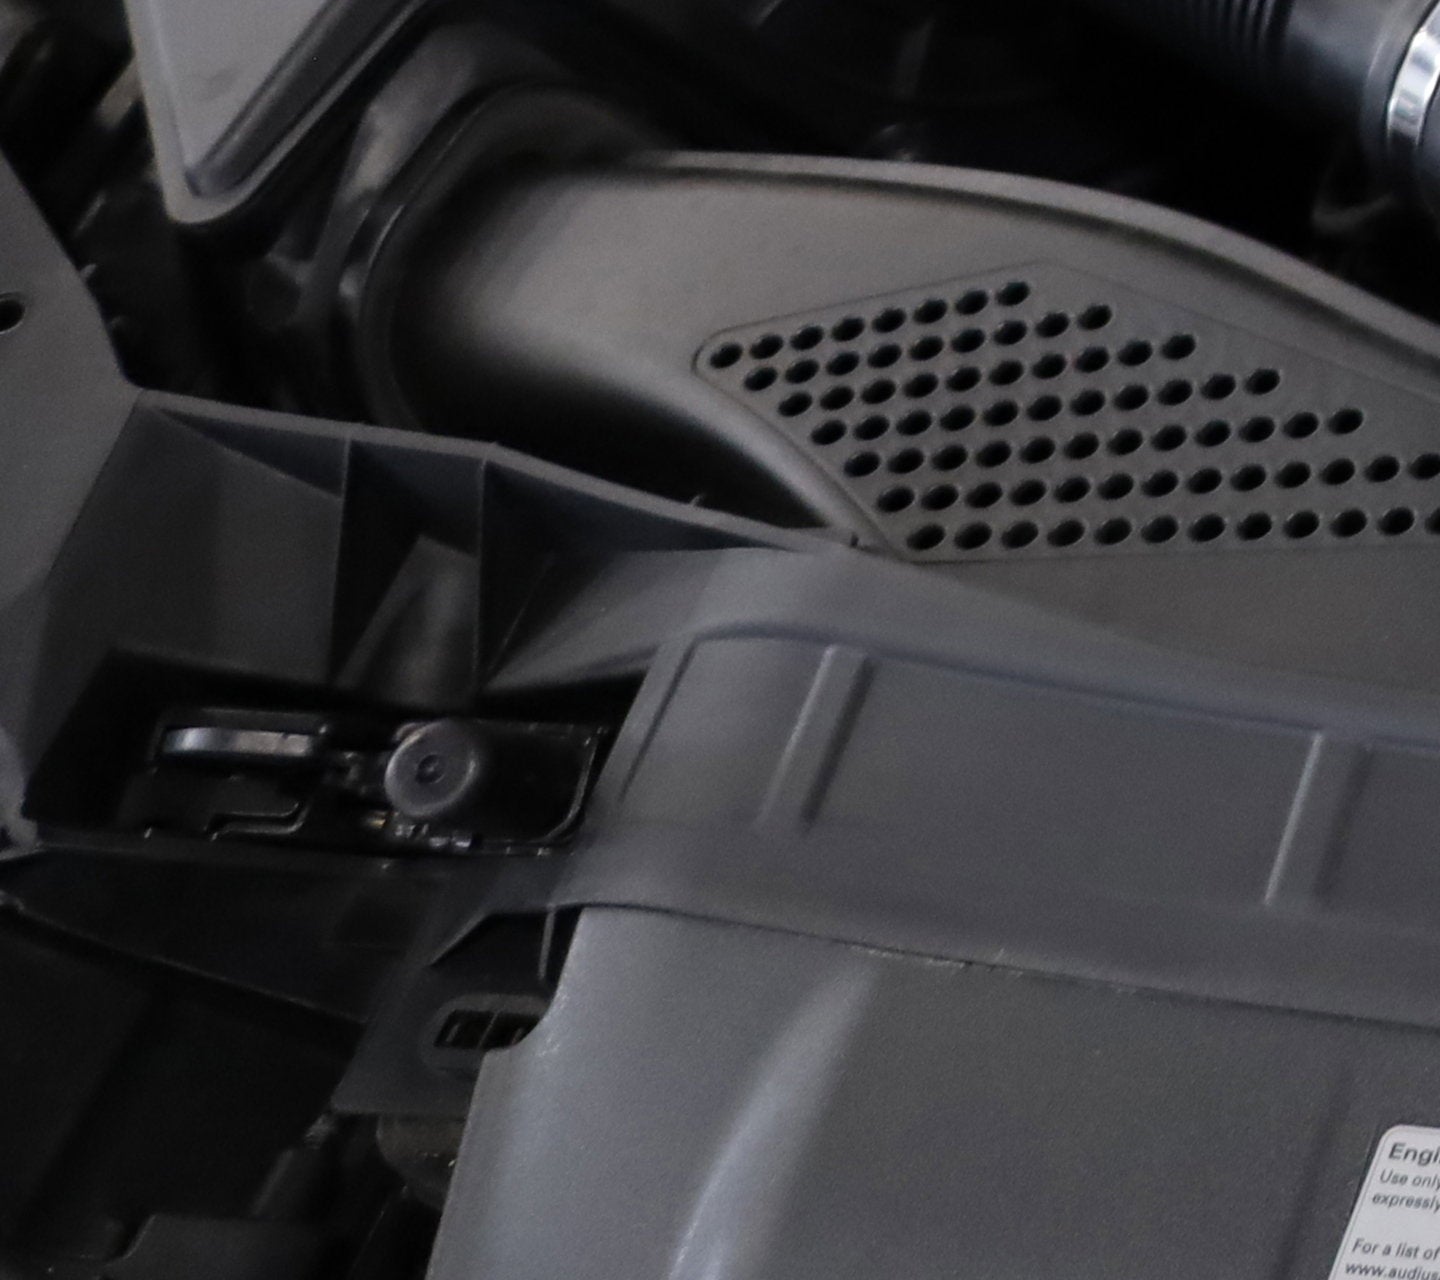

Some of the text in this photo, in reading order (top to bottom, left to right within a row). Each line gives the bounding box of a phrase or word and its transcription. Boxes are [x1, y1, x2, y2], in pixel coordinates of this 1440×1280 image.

[1379, 1169, 1409, 1186] Use
[1351, 1237, 1380, 1255] For
[1382, 1244, 1393, 1257] a
[1395, 1242, 1420, 1259] list
